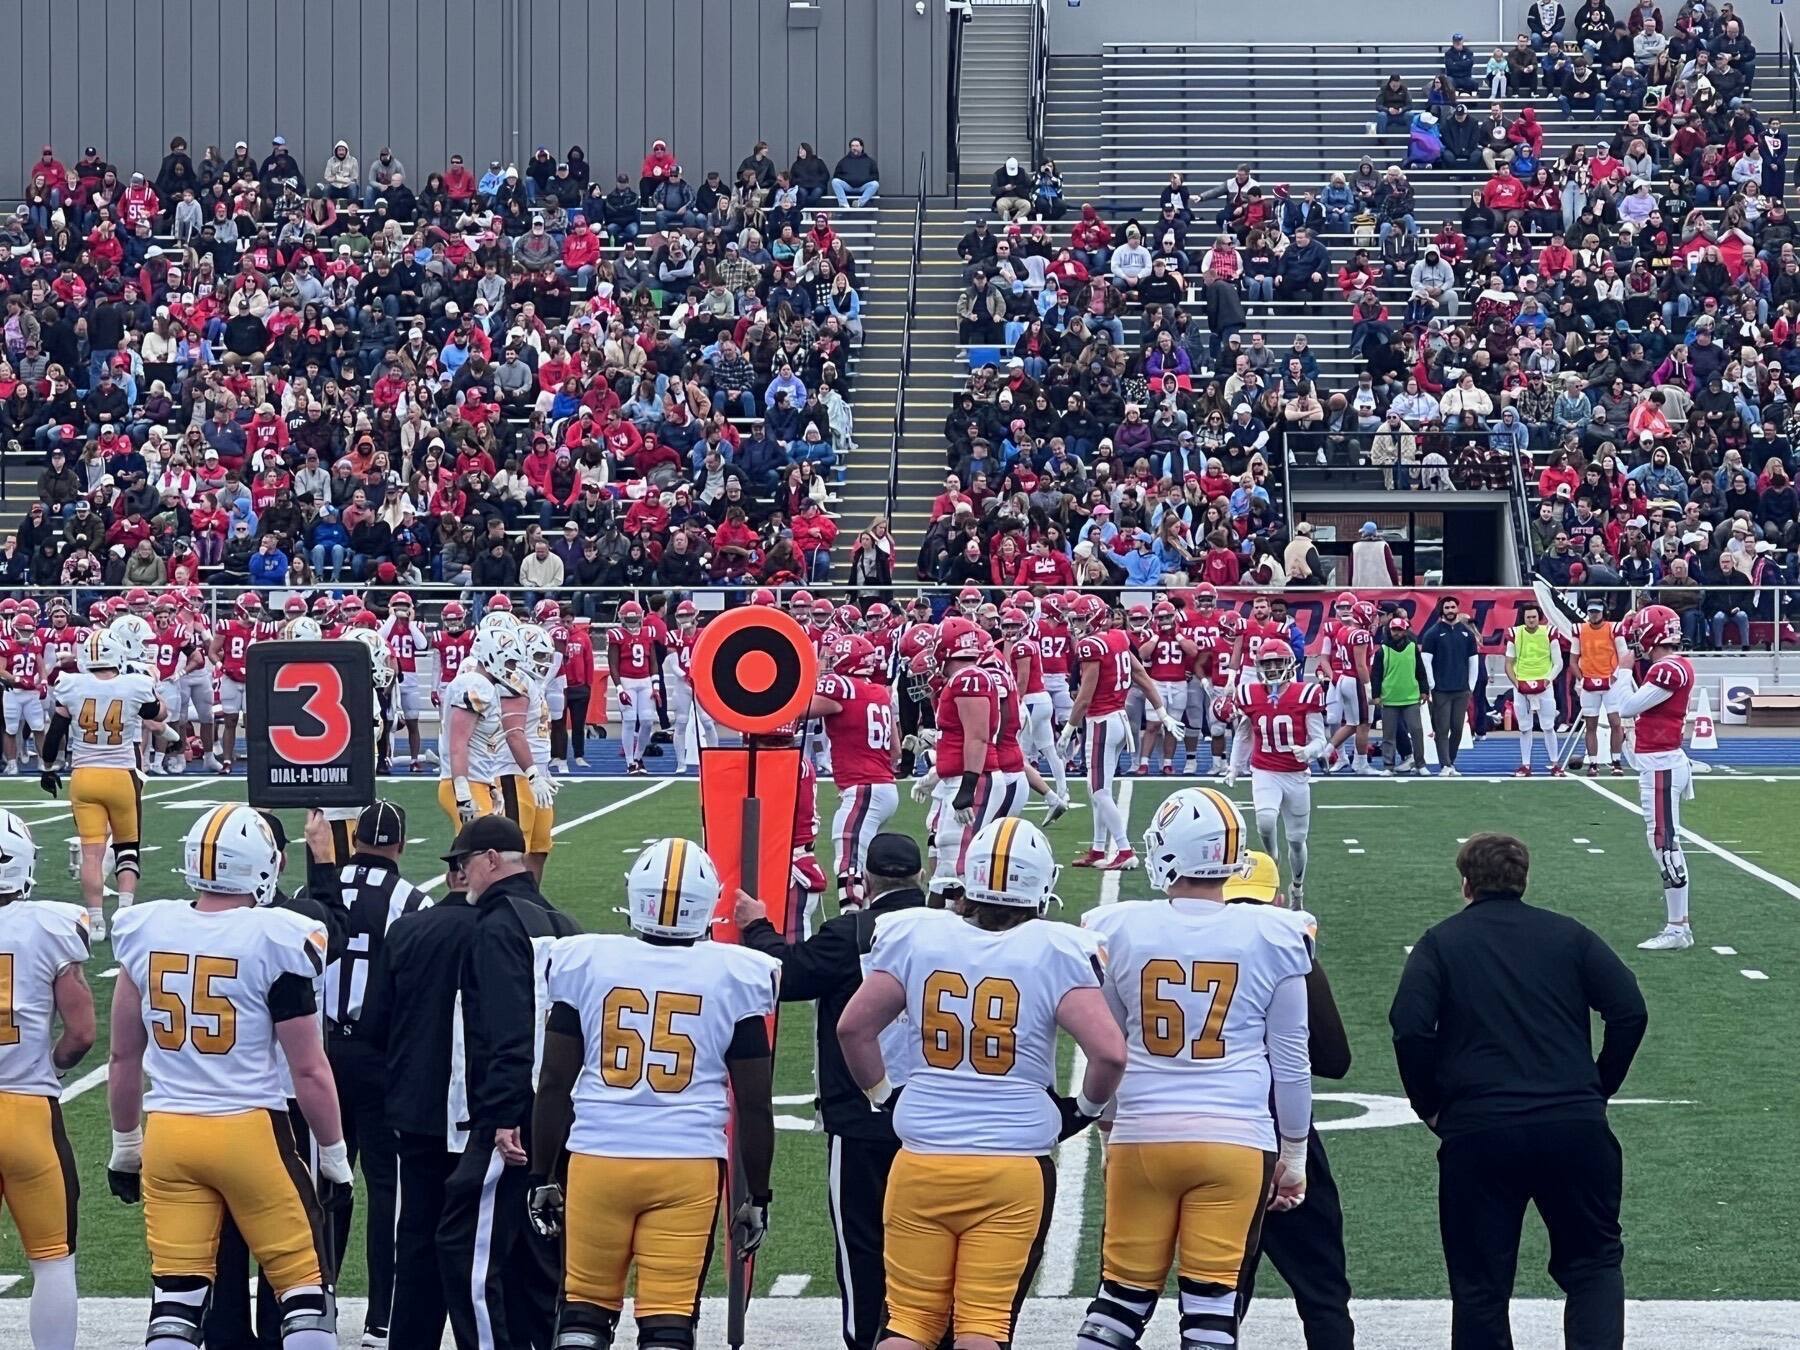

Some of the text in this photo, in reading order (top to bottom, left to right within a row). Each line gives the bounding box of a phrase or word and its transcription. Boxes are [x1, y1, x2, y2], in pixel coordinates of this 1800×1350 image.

[834, 640, 853, 653] 68
[1017, 645, 1025, 656] 5
[1041, 636, 1066, 658] 87
[1079, 644, 1091, 659] 19
[1356, 634, 1370, 644] 20
[13, 653, 36, 677] 26
[631, 643, 645, 668] 9
[1157, 640, 1182, 665] 35
[960, 676, 980, 692] 71
[1114, 651, 1132, 692] 19
[1655, 667, 1672, 685] 11
[817, 679, 836, 695] 68
[78, 698, 124, 746] 44
[268, 662, 351, 765] 3
[866, 703, 891, 750] 68
[1257, 714, 1294, 753] 10
[270, 767, 349, 783] DIAL-A-DOWN
[149, 951, 239, 1055] 55
[1140, 959, 1239, 1060] 67
[921, 969, 1020, 1076] 68
[600, 986, 703, 1094] 65
